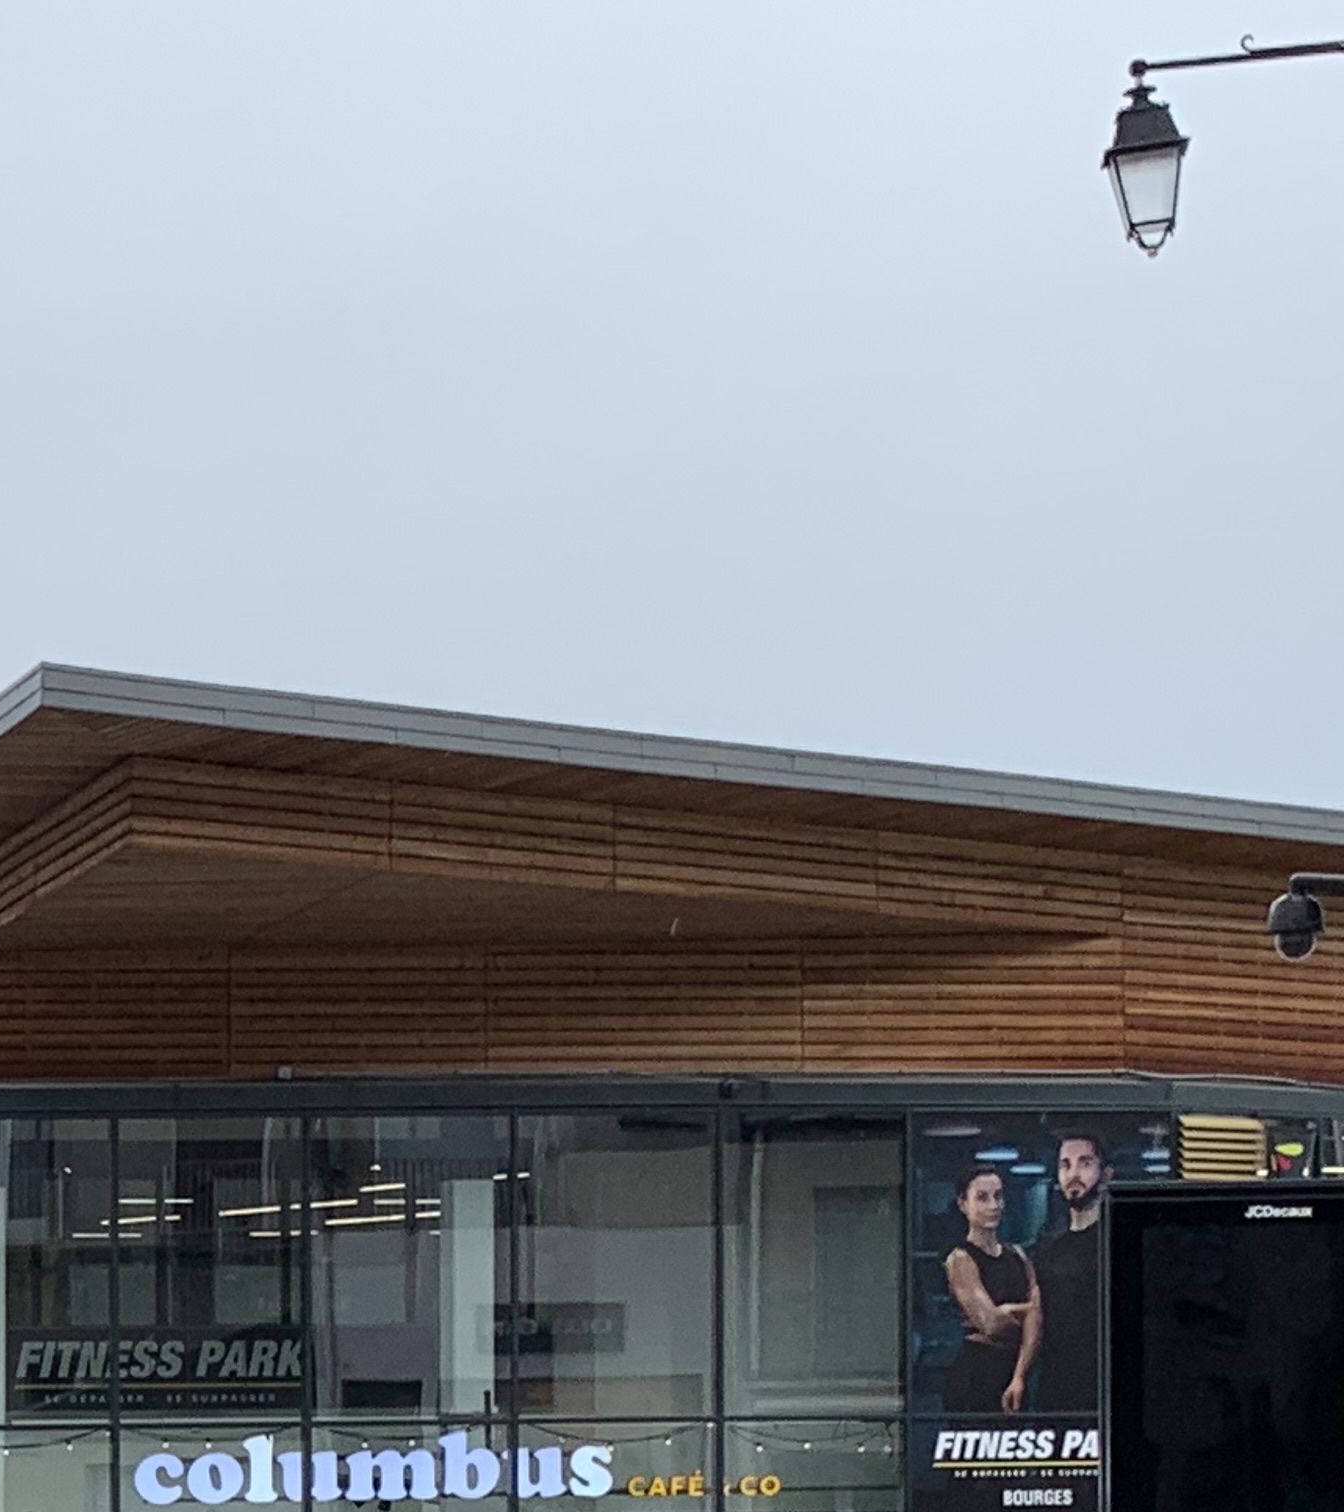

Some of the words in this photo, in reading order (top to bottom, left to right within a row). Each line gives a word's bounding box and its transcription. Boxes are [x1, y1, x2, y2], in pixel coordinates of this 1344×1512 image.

[1244, 1204, 1313, 1219] JCDecaux
[14, 1339, 186, 1380] FITNESS
[195, 1338, 303, 1378] PARK
[933, 1430, 1056, 1460] FITNESS
[1060, 1429, 1100, 1459] PA
[133, 1430, 613, 1504] columbus
[628, 1469, 705, 1499] CAFÉ
[1002, 1488, 1074, 1507] BOURGES
